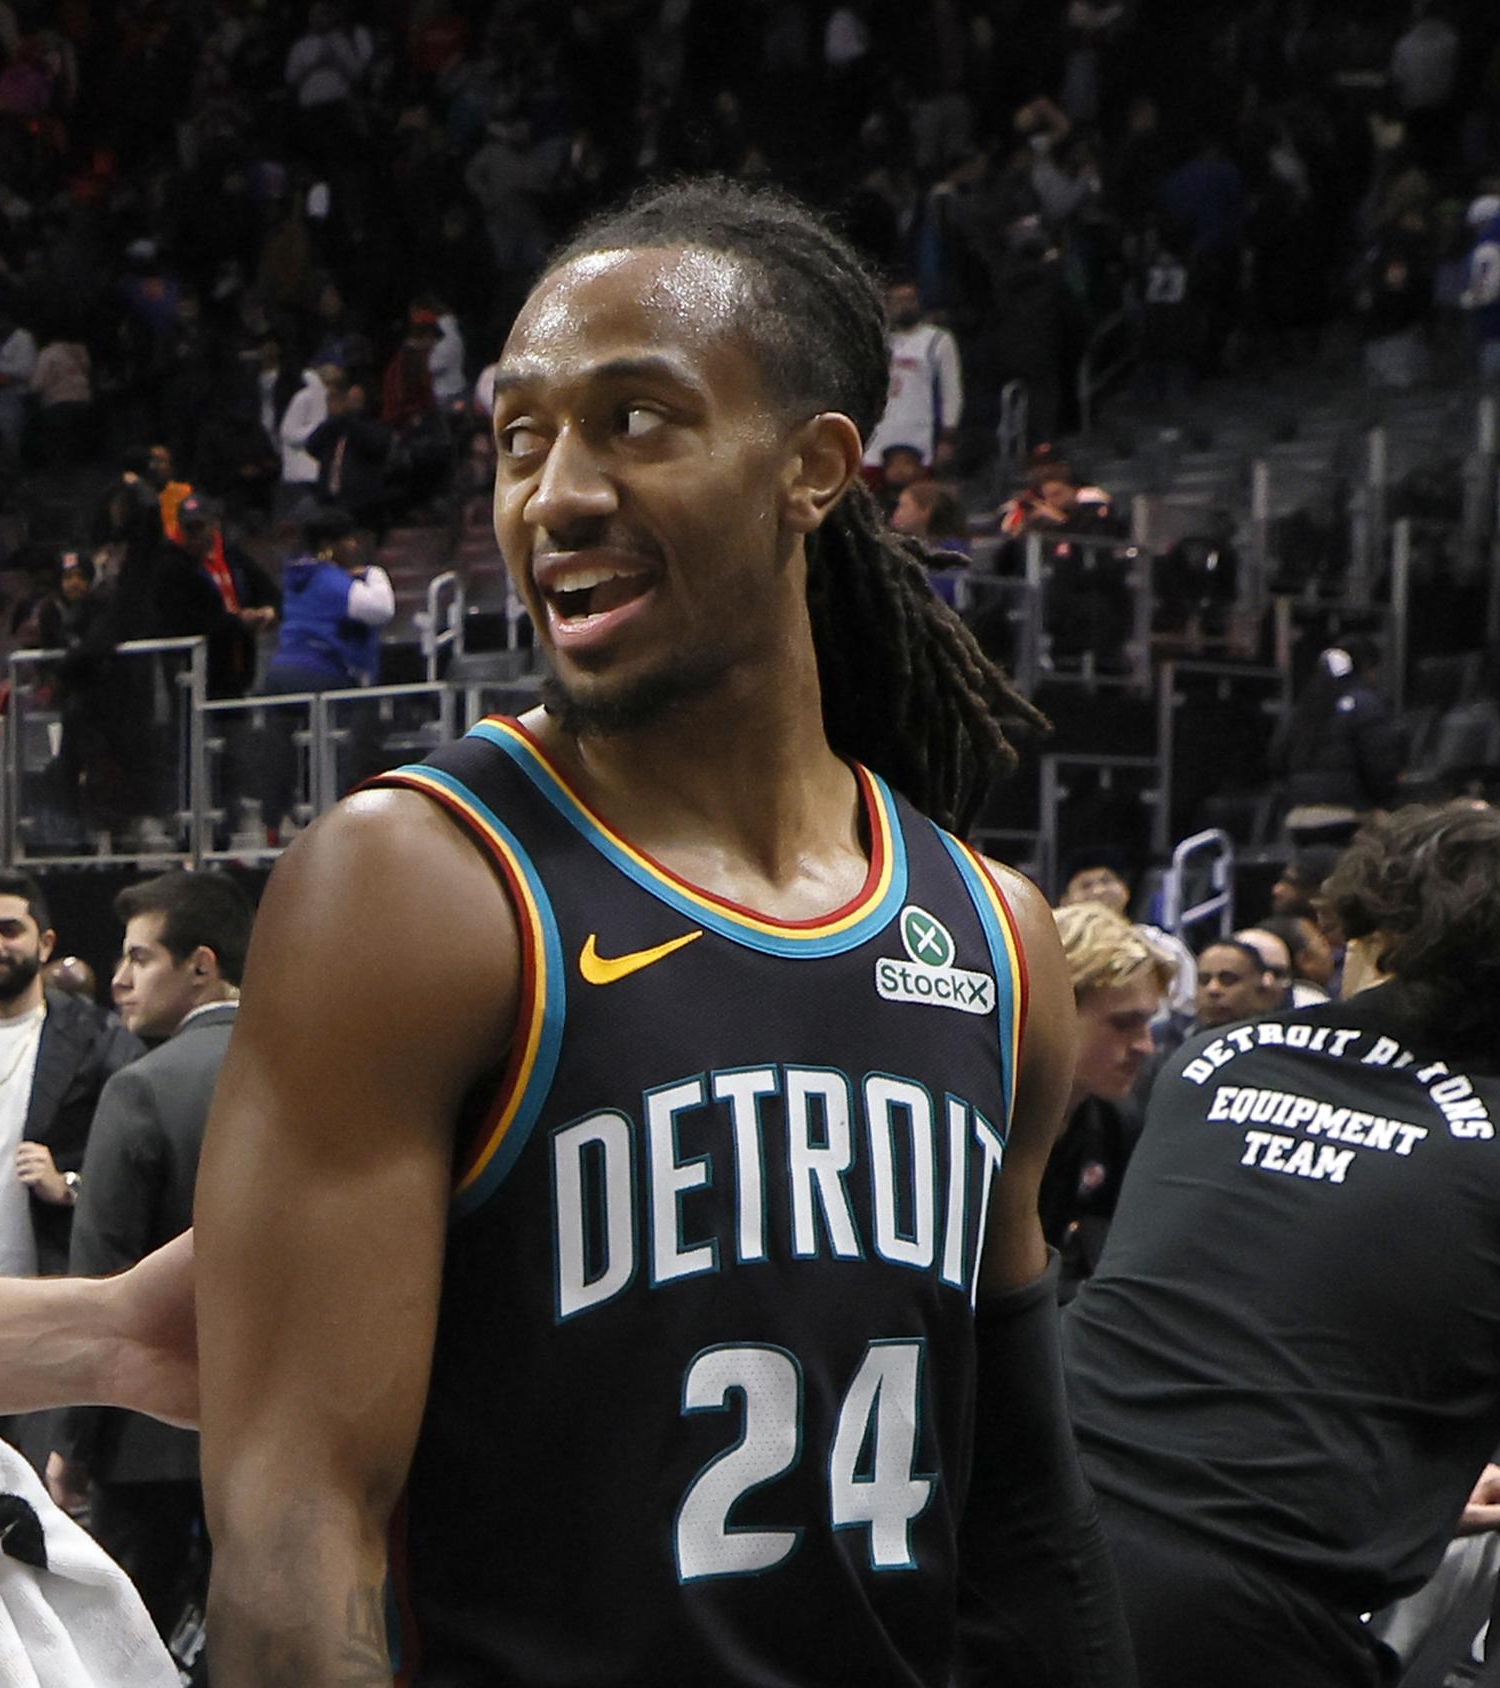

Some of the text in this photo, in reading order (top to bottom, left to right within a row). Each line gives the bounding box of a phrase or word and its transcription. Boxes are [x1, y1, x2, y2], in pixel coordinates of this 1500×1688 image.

[880, 964, 988, 1008] StockX
[1182, 1022, 1495, 1139] DETROIT PITONS
[1207, 1086, 1428, 1155] EQUIPMENT
[551, 1063, 1006, 1322] DETROIT
[1240, 1130, 1356, 1184] TEAM
[673, 1337, 938, 1584] 24
